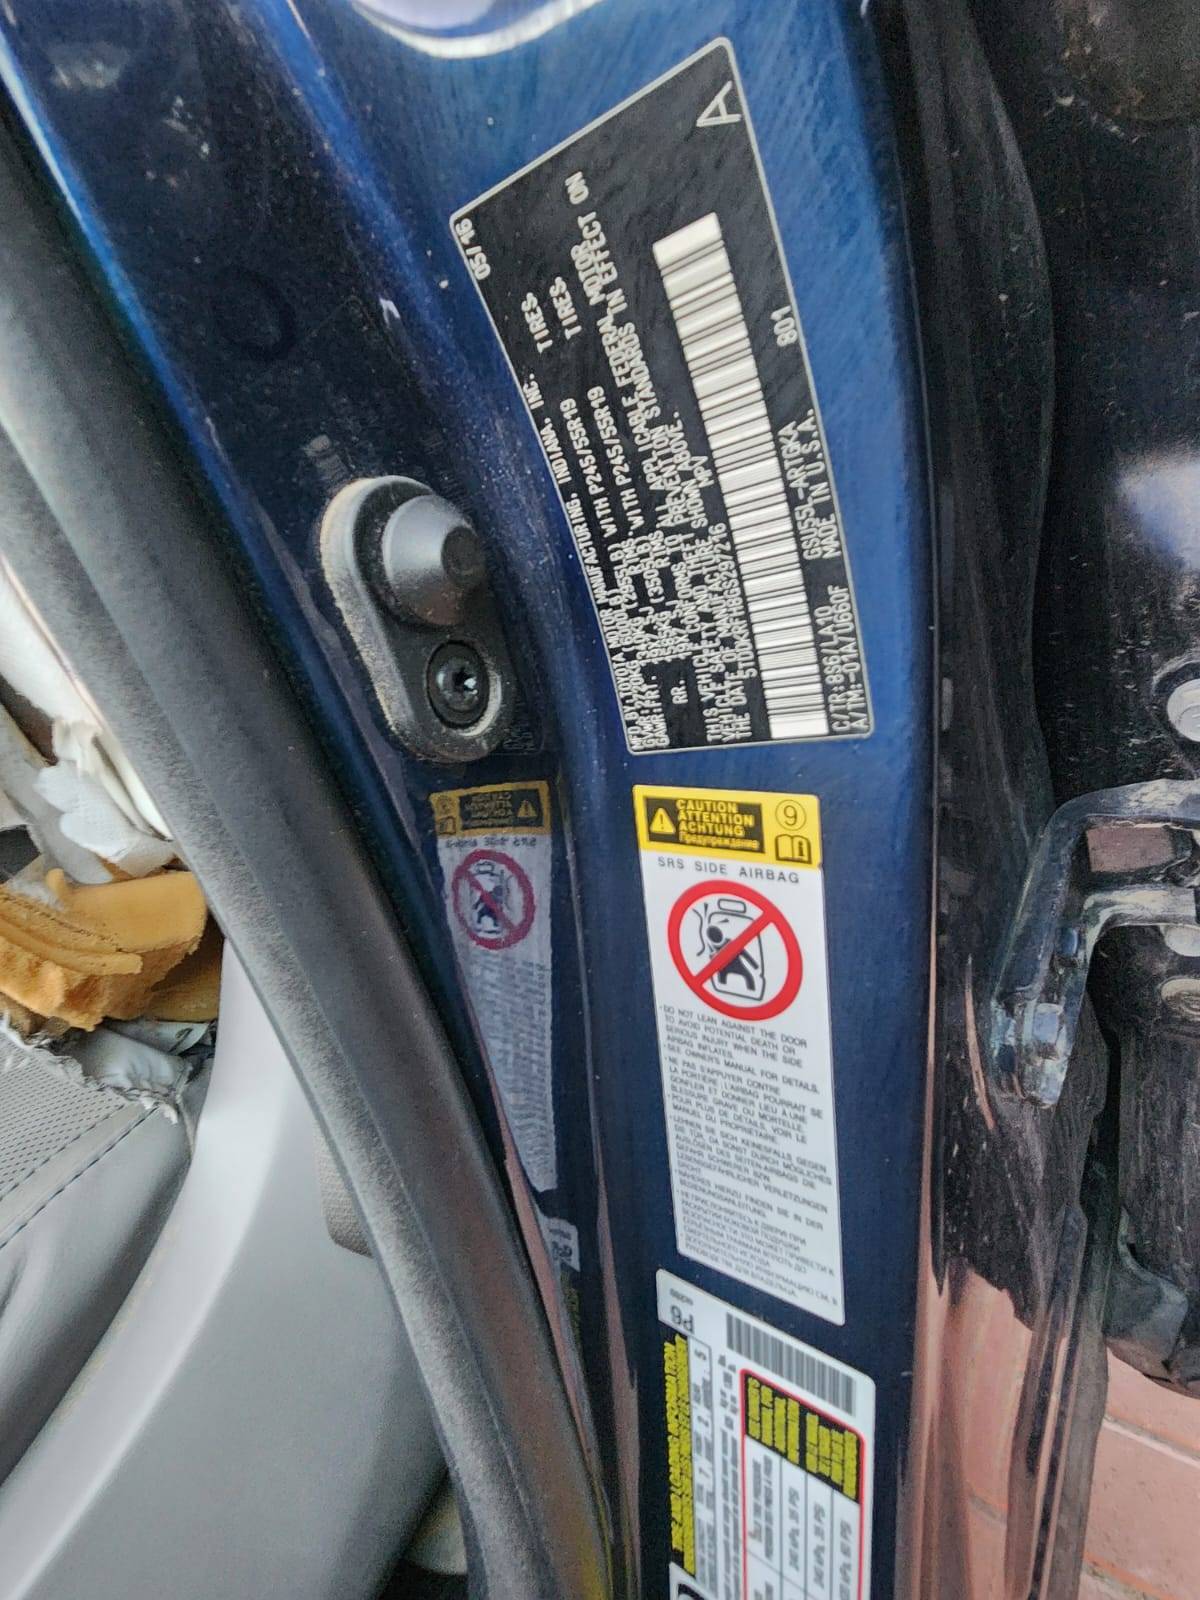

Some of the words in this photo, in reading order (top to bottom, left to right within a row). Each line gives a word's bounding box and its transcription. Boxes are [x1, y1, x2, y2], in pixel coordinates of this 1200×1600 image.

[696, 80, 741, 127] A
[564, 171, 589, 205] ON
[455, 218, 491, 280] 05/16
[577, 211, 618, 286] EFFECT
[571, 240, 605, 306] MOTOR
[520, 292, 553, 354] TIRES.
[549, 276, 582, 341] TIRES.
[605, 288, 628, 315] IN
[597, 307, 633, 388] FEDERAL
[770, 305, 798, 348] 801
[523, 373, 545, 410] INC.
[618, 321, 662, 421] STANDARDS
[559, 397, 605, 496] P245/55R19
[587, 385, 632, 486] P245/55R19
[621, 394, 665, 491] APPLICABLE
[665, 411, 692, 472] ABOVE.
[798, 408, 826, 477] U.S.A.
[651, 424, 690, 525] PREVENTION
[690, 455, 715, 489] MPV
[807, 481, 832, 506] IN
[593, 497, 618, 538] WITH
[620, 487, 645, 530] WITH
[656, 500, 675, 529] ALL
[680, 477, 709, 530] SHOWN
[664, 533, 682, 555] TO
[677, 531, 703, 577] THEFT
[816, 514, 842, 559] MADE
[607, 543, 639, 611] (2955LB)
[636, 535, 665, 604] (3505LB)
[695, 538, 733, 638] MANUFACTURE
[670, 561, 700, 633] CONFORMS
[692, 583, 713, 613] AND
[600, 607, 621, 649] MOTOR
[607, 588, 635, 652] (6000LB)
[629, 615, 651, 667] 1340KG
[700, 622, 726, 673] SAFETY
[720, 645, 737, 663] OF
[814, 604, 850, 733] C/TR:8S6/LA10
[671, 680, 688, 705] RR.
[687, 642, 715, 702] VEHICLE
[724, 670, 747, 706] DATE
[702, 707, 723, 742] THIS
[709, 681, 737, 742] VEHICLE
[734, 712, 752, 739] THE
[676, 799, 738, 814] CAUTION
[677, 810, 755, 827] ATTENTION
[783, 805, 798, 826] 9
[679, 821, 746, 837] ACHTUNG
[658, 856, 685, 869] SRS
[695, 860, 728, 875] SIDE
[739, 867, 800, 884] AIRBAG
[663, 1005, 674, 1014] DO
[677, 1008, 693, 1019] NOT
[697, 1013, 717, 1025] LEAN
[720, 1019, 755, 1034] AGAINST
[760, 1028, 776, 1040] THE
[780, 1033, 806, 1048] DOOR
[666, 1033, 693, 1048] AIRBAG
[678, 1018, 700, 1030] AVOID
[704, 1024, 745, 1042] POTENTIAL
[750, 1036, 778, 1050] DEATH
[782, 1044, 795, 1055] OR
[667, 1043, 681, 1054] SEE
[724, 1059, 756, 1075] MANUAL
[760, 1069, 778, 1081] FOR
[733, 1041, 757, 1055] WHEN
[761, 1049, 777, 1061] THE
[782, 1054, 802, 1068] SIDE
